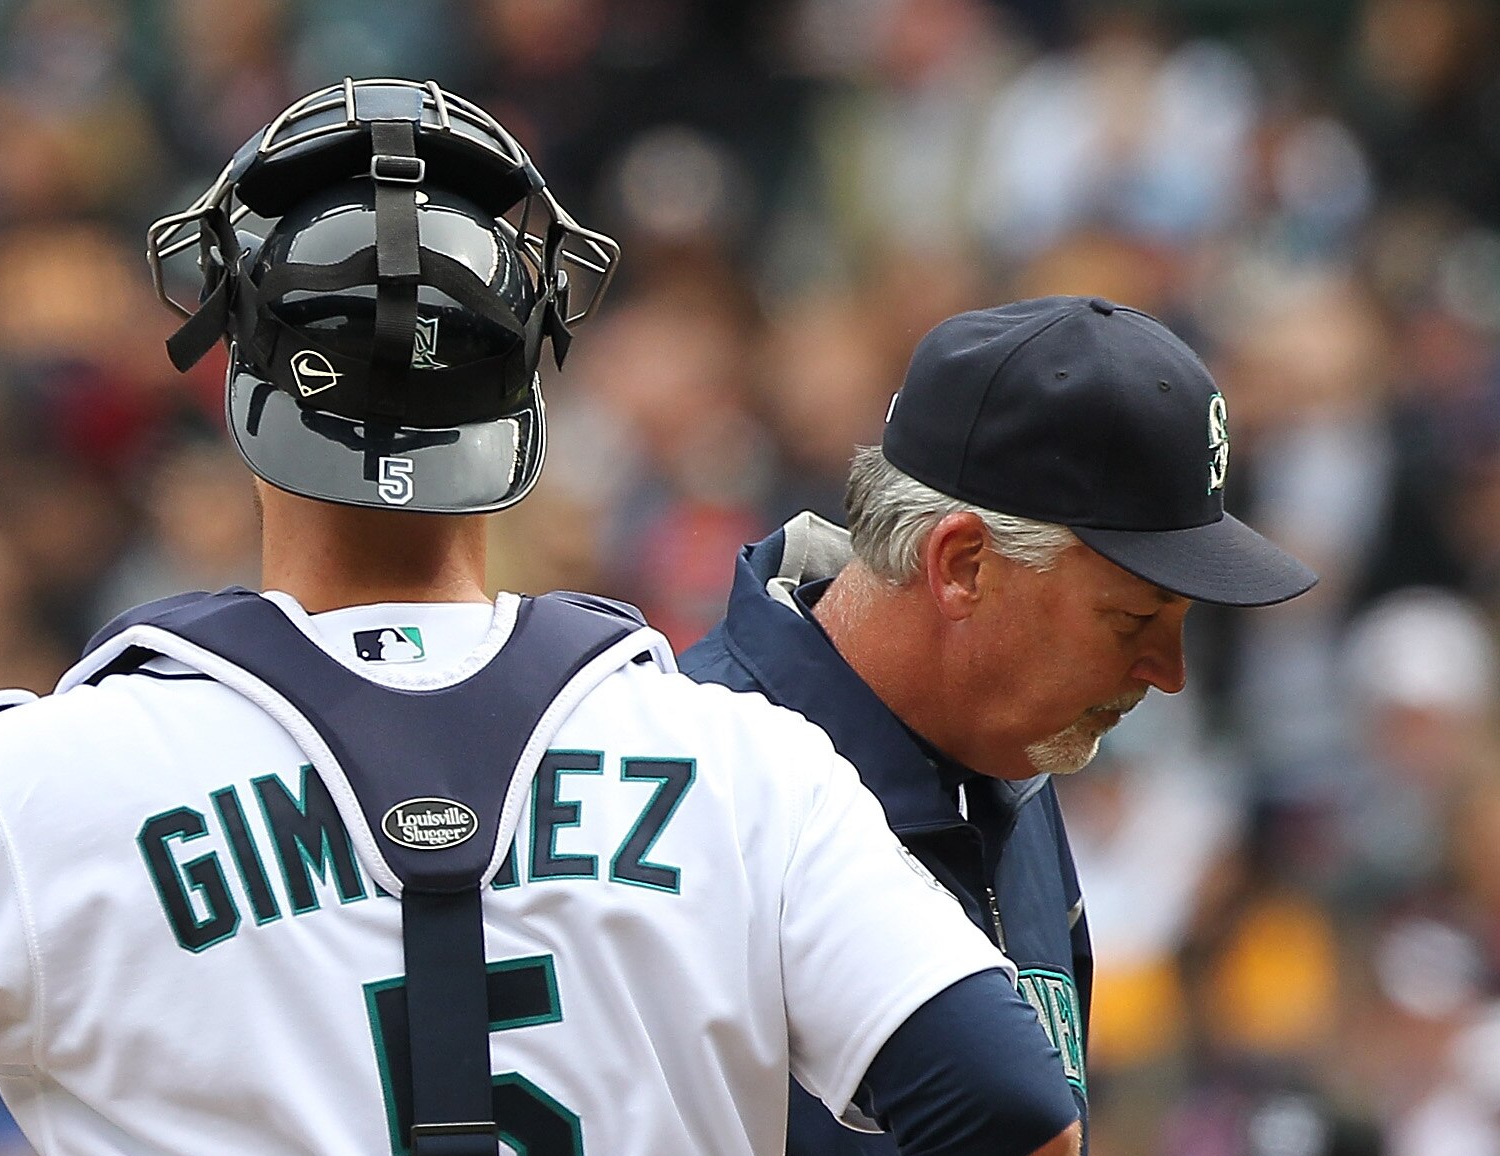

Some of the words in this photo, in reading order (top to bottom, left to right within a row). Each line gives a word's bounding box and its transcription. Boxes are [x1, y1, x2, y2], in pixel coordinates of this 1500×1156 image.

[378, 457, 415, 505] 5
[396, 808, 470, 827] Louisville
[135, 748, 697, 953] GIMEZ
[403, 826, 467, 844] Slugger
